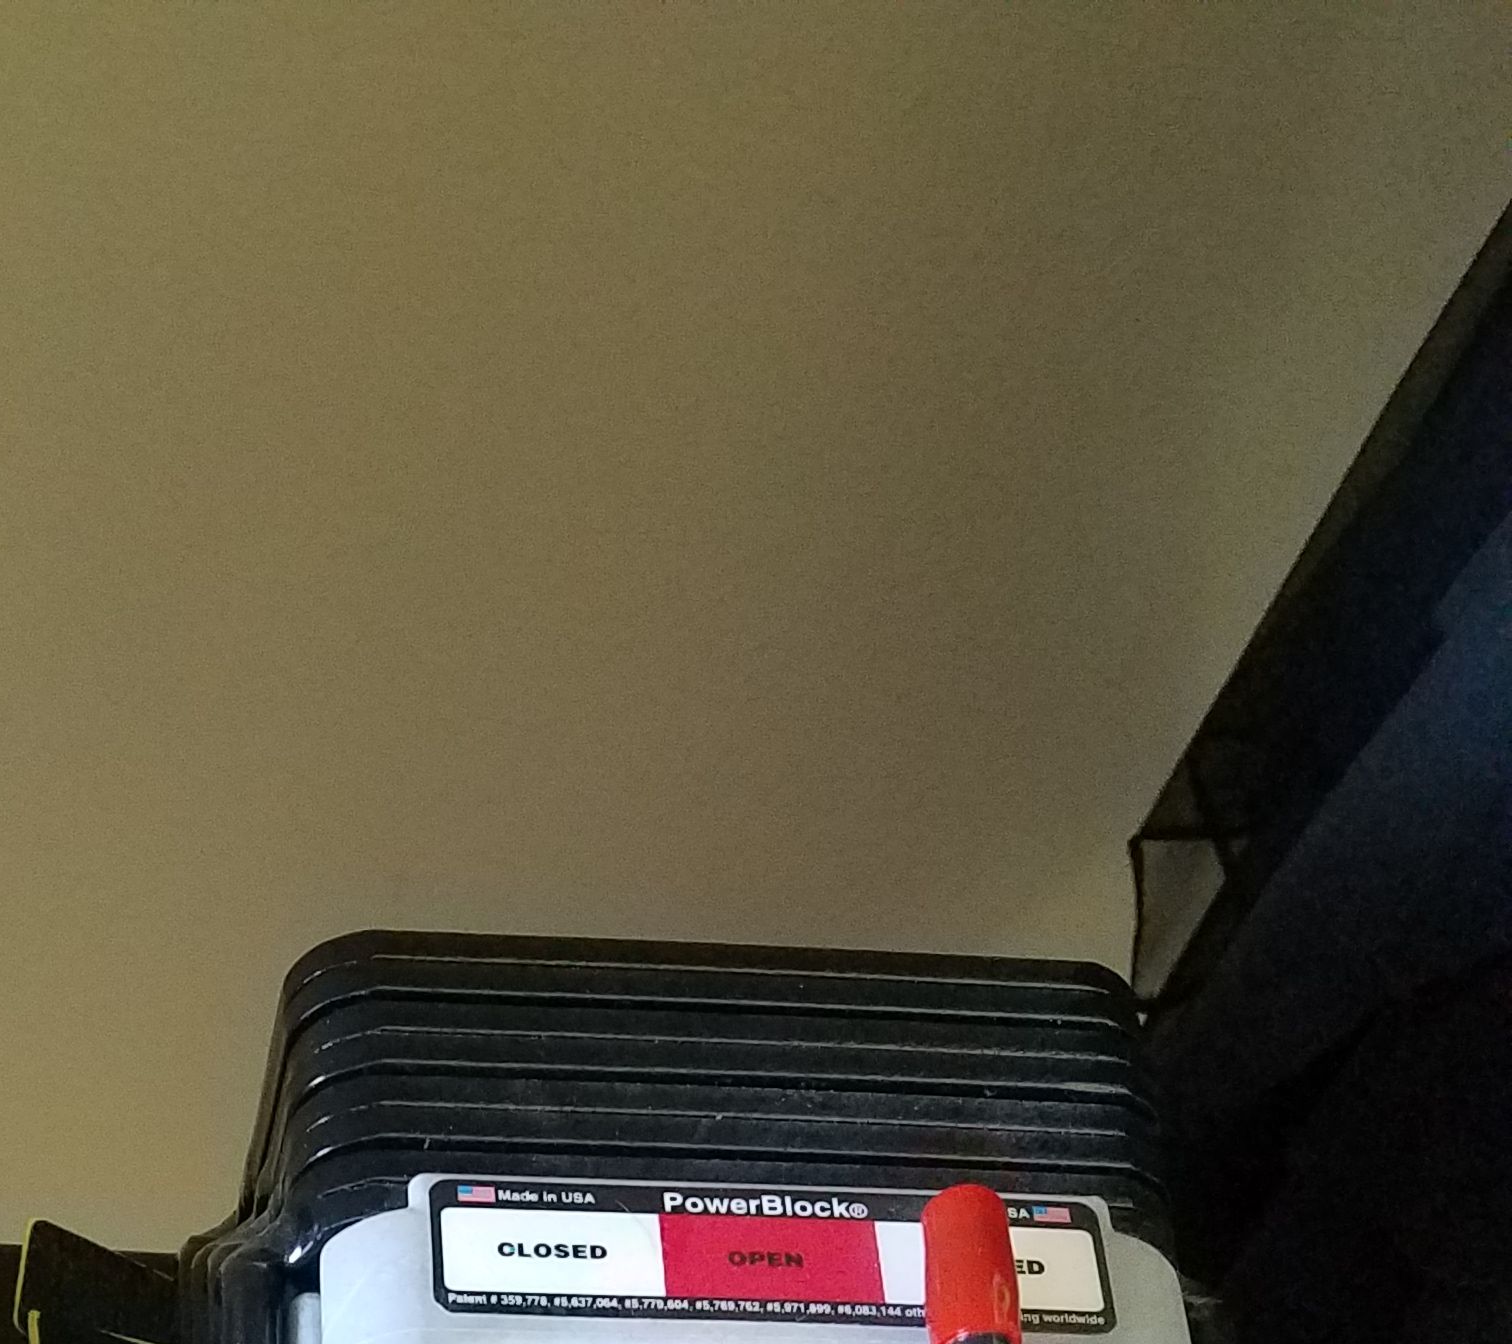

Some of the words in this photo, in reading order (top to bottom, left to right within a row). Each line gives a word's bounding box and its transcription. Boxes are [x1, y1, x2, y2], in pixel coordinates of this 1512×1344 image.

[498, 1190, 539, 1202] Made
[543, 1191, 557, 1203] in
[561, 1192, 595, 1204] USA
[497, 1242, 608, 1260] CLOSED
[728, 1250, 804, 1268] OPEN
[448, 1293, 487, 1304] Patent
[1042, 1314, 1105, 1325] worldwide
